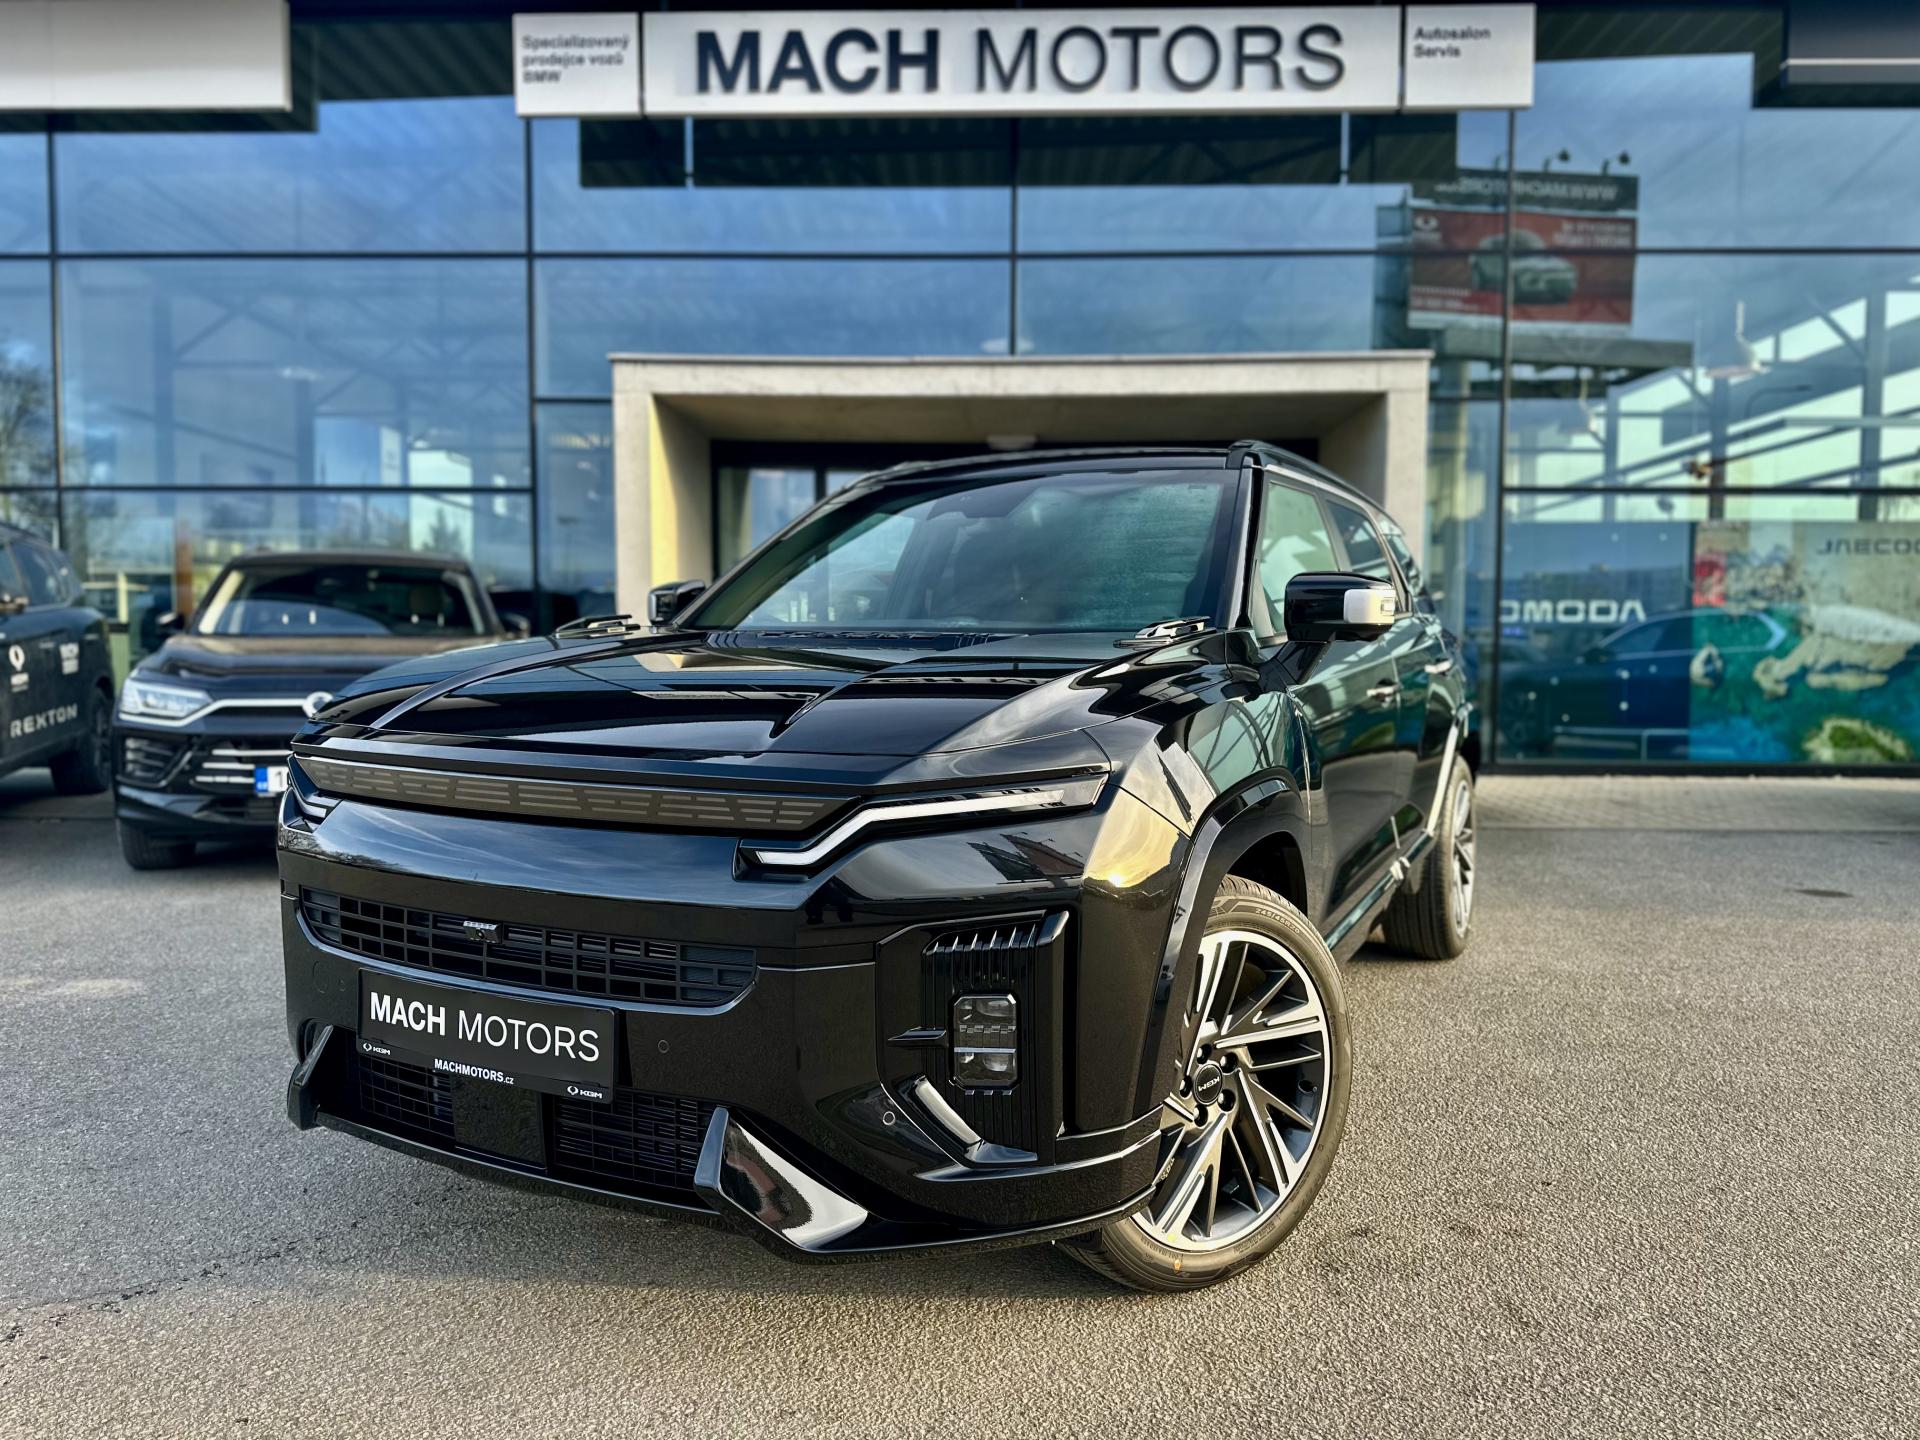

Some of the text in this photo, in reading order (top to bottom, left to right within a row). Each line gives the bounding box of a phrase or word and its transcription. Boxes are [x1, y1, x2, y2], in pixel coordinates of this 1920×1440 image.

[1414, 26, 1491, 41] Autosalon
[697, 23, 1345, 95] MACH MOTORS
[1413, 43, 1462, 59] Servis
[522, 70, 562, 84] BMW
[10, 702, 79, 739] REXTON
[370, 991, 600, 1062] MACH MOTORS
[434, 1058, 514, 1085] MACHMOTORS.cz
